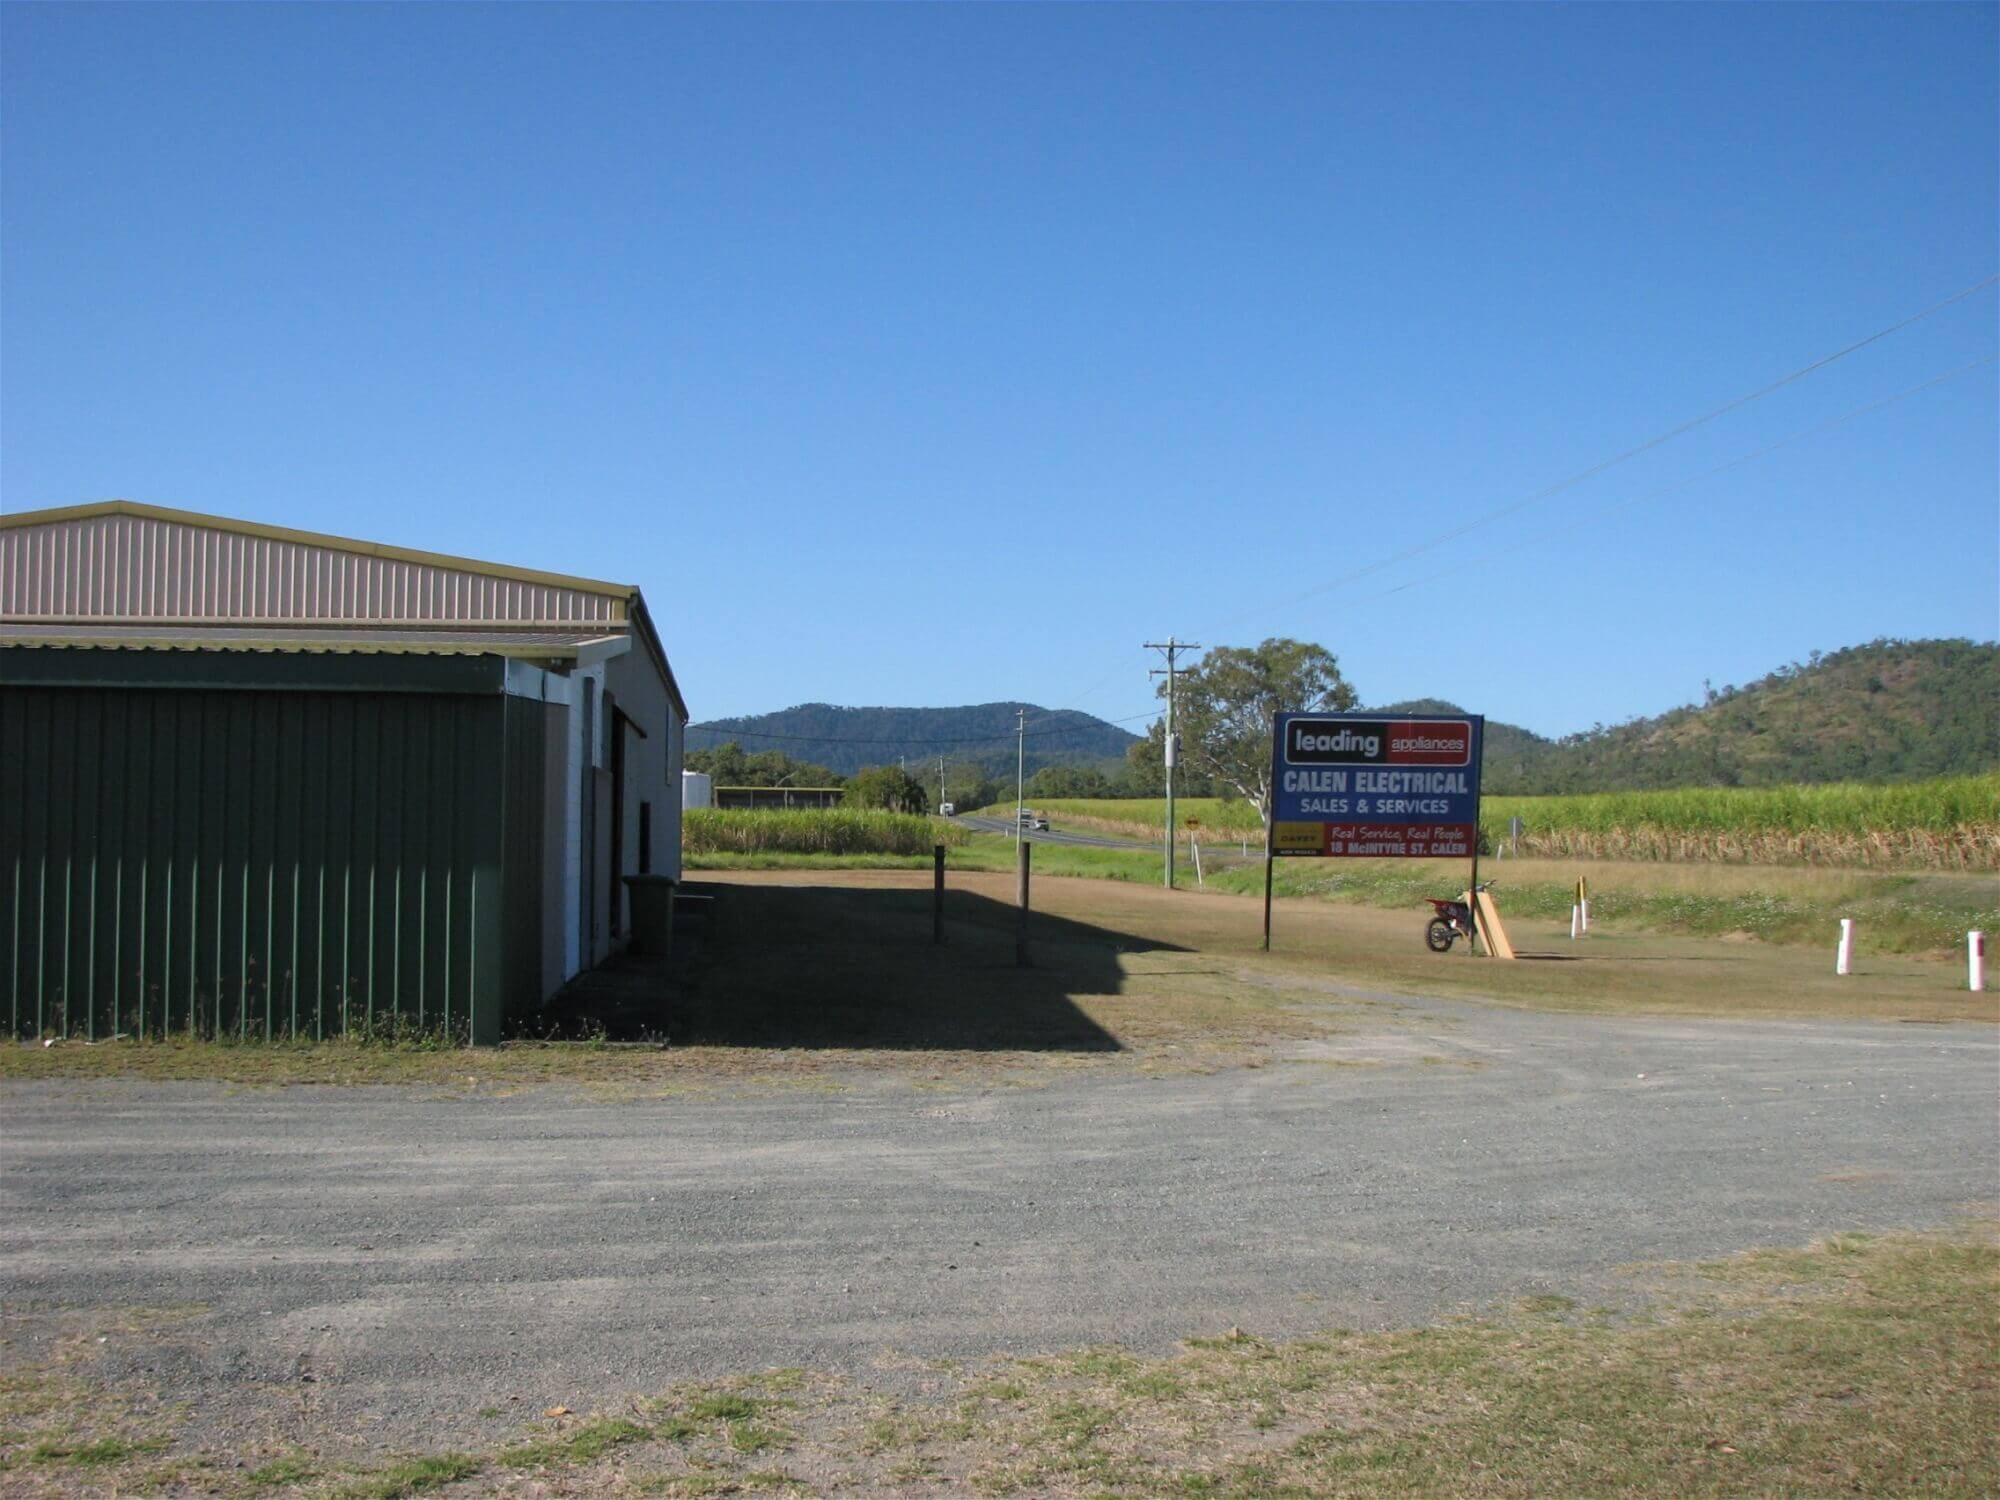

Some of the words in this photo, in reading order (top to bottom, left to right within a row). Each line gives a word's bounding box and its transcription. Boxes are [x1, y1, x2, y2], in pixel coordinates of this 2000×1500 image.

[1296, 729, 1379, 757] leading
[1391, 735, 1464, 751] appliances
[1283, 771, 1347, 793] CALEN
[1356, 772, 1468, 794] ELECTRICAL
[1300, 799, 1348, 813] SALES
[1356, 800, 1369, 814] &
[1376, 799, 1449, 814] SERVICES
[1332, 827, 1355, 840] Real
[1407, 827, 1431, 840] Real
[1434, 827, 1464, 844] People
[1330, 842, 1343, 853] 18
[1348, 842, 1406, 854] McINTYRE
[1410, 843, 1427, 854] ST.
[1431, 843, 1467, 854] CALEN
